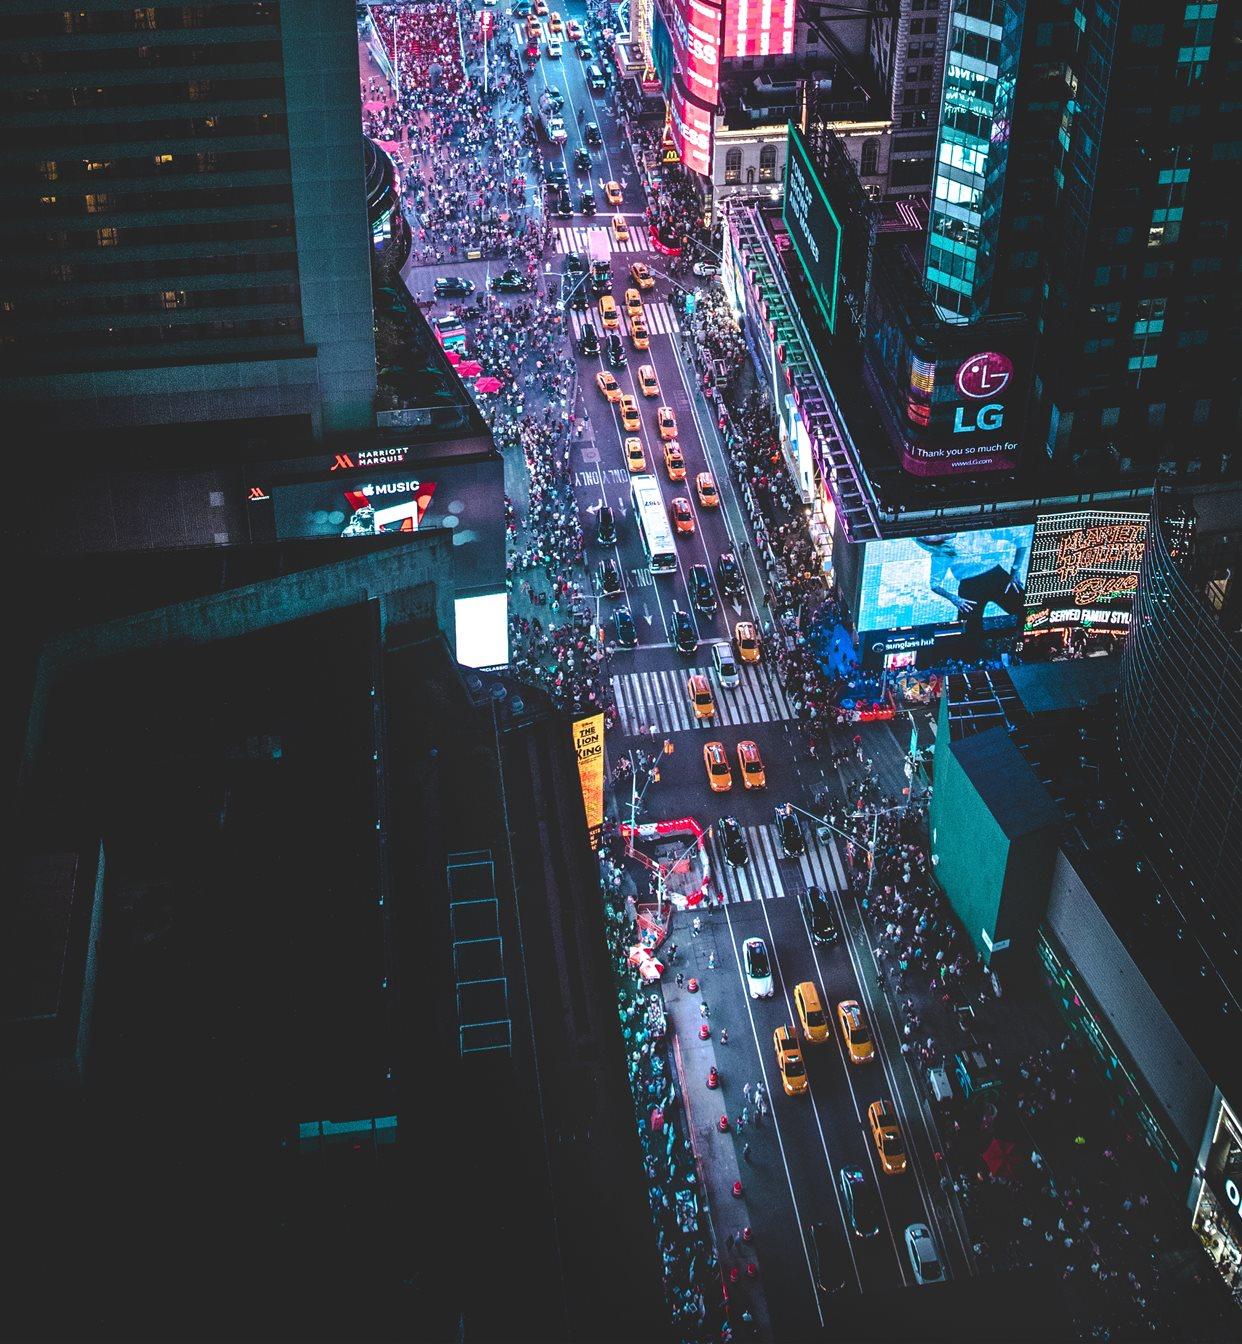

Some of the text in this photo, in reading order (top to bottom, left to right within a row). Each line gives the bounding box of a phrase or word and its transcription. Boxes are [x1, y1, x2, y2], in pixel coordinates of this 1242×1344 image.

[953, 403, 1005, 434] LG
[358, 446, 409, 459] MARRIOTT
[917, 447, 945, 458] Thank
[946, 448, 963, 458] you
[978, 442, 1002, 453] much
[1004, 441, 1018, 451] for
[358, 454, 404, 466] MARQUIS
[575, 470, 599, 487] ONLY
[602, 468, 629, 484] ONLY
[375, 480, 420, 496] MUSIC
[626, 568, 653, 588] ONLY
[1049, 609, 1081, 623] SERVED
[1081, 609, 1111, 624] FAMILY
[885, 637, 935, 652] sunglass hut
[579, 726, 596, 737] THE
[576, 734, 599, 749] LION
[576, 744, 602, 760] KING
